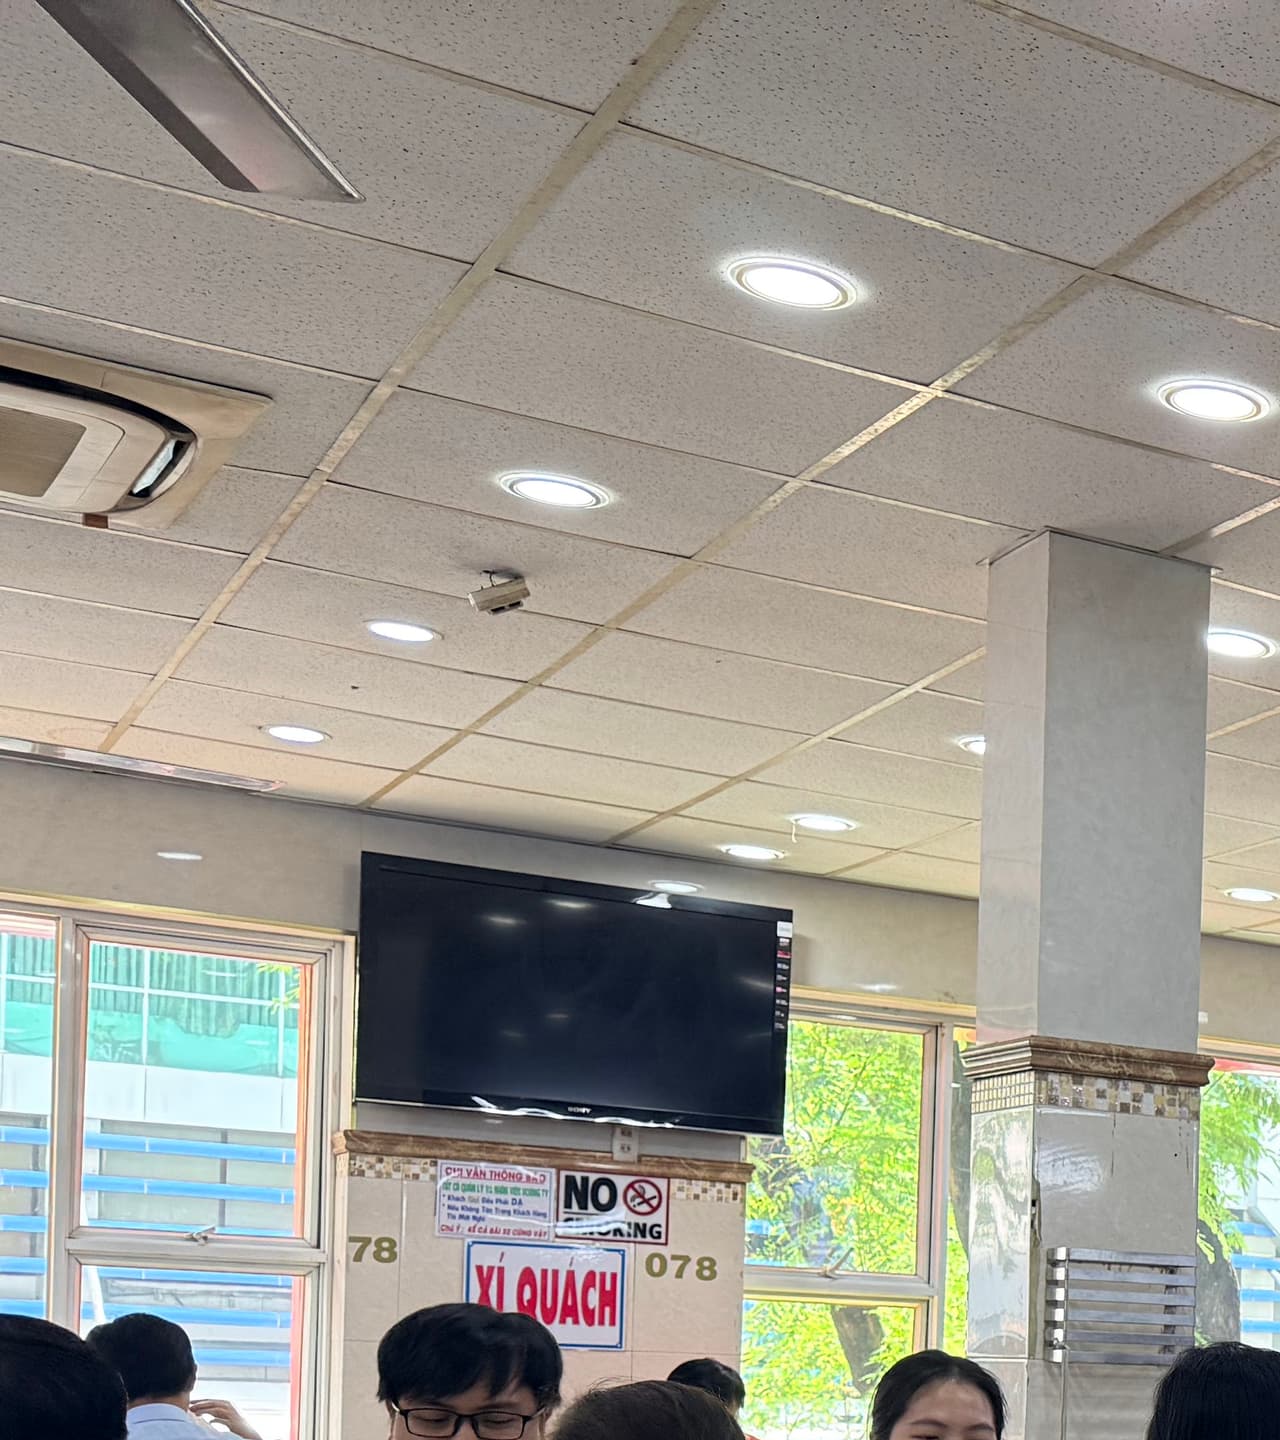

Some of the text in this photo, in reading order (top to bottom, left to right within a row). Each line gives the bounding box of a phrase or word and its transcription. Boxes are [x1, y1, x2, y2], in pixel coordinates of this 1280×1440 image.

[563, 1174, 618, 1213] NO
[348, 1235, 398, 1264] 78
[645, 1252, 718, 1281] 078
[475, 1251, 618, 1328] XÍ QUÁCH
